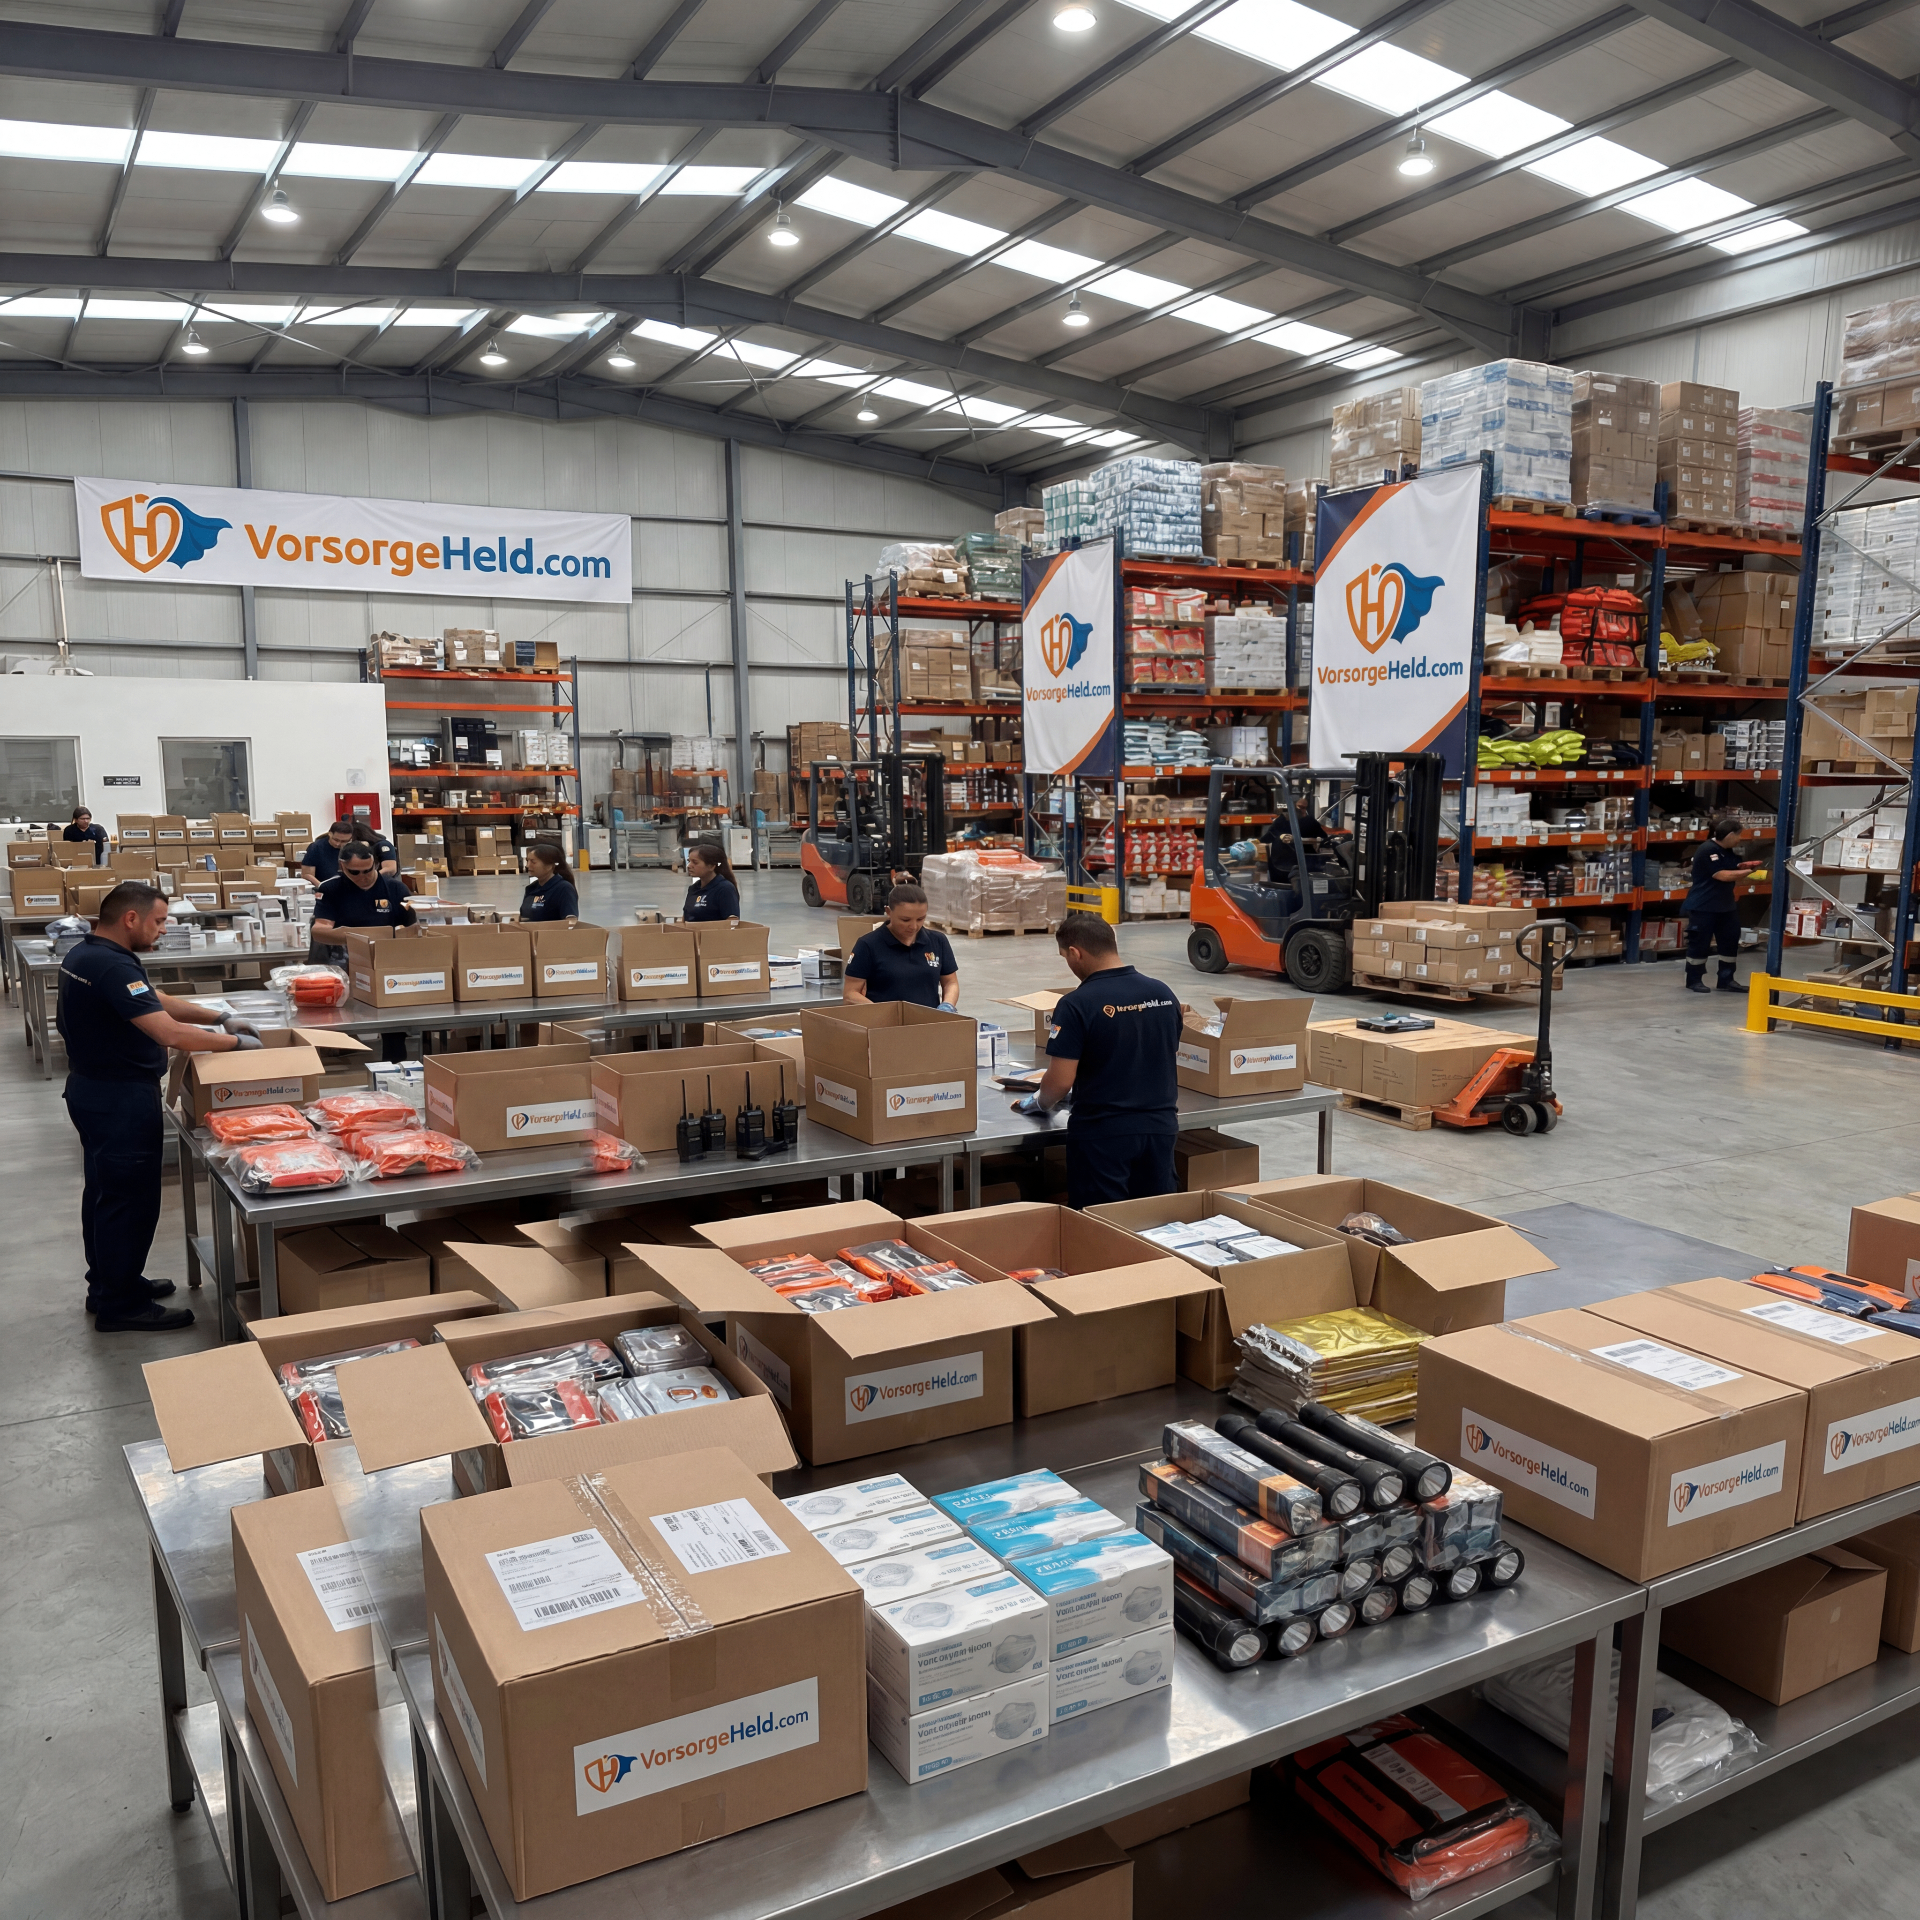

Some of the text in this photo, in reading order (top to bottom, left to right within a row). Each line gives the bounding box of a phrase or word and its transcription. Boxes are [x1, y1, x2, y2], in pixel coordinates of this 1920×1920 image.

[243, 523, 612, 579] VorsorgeHeld.com
[1317, 655, 1464, 687] VorsorgeHeld.com
[1025, 680, 1111, 704] VorsorgeHeld.com
[878, 1370, 978, 1401] VorsorgeHeld.com
[1490, 1438, 1589, 1498] VorsorgeHeld.com
[1697, 1462, 1779, 1499] VorsorgeHeld.com
[639, 1710, 810, 1770] VorsorgeHeld.com
